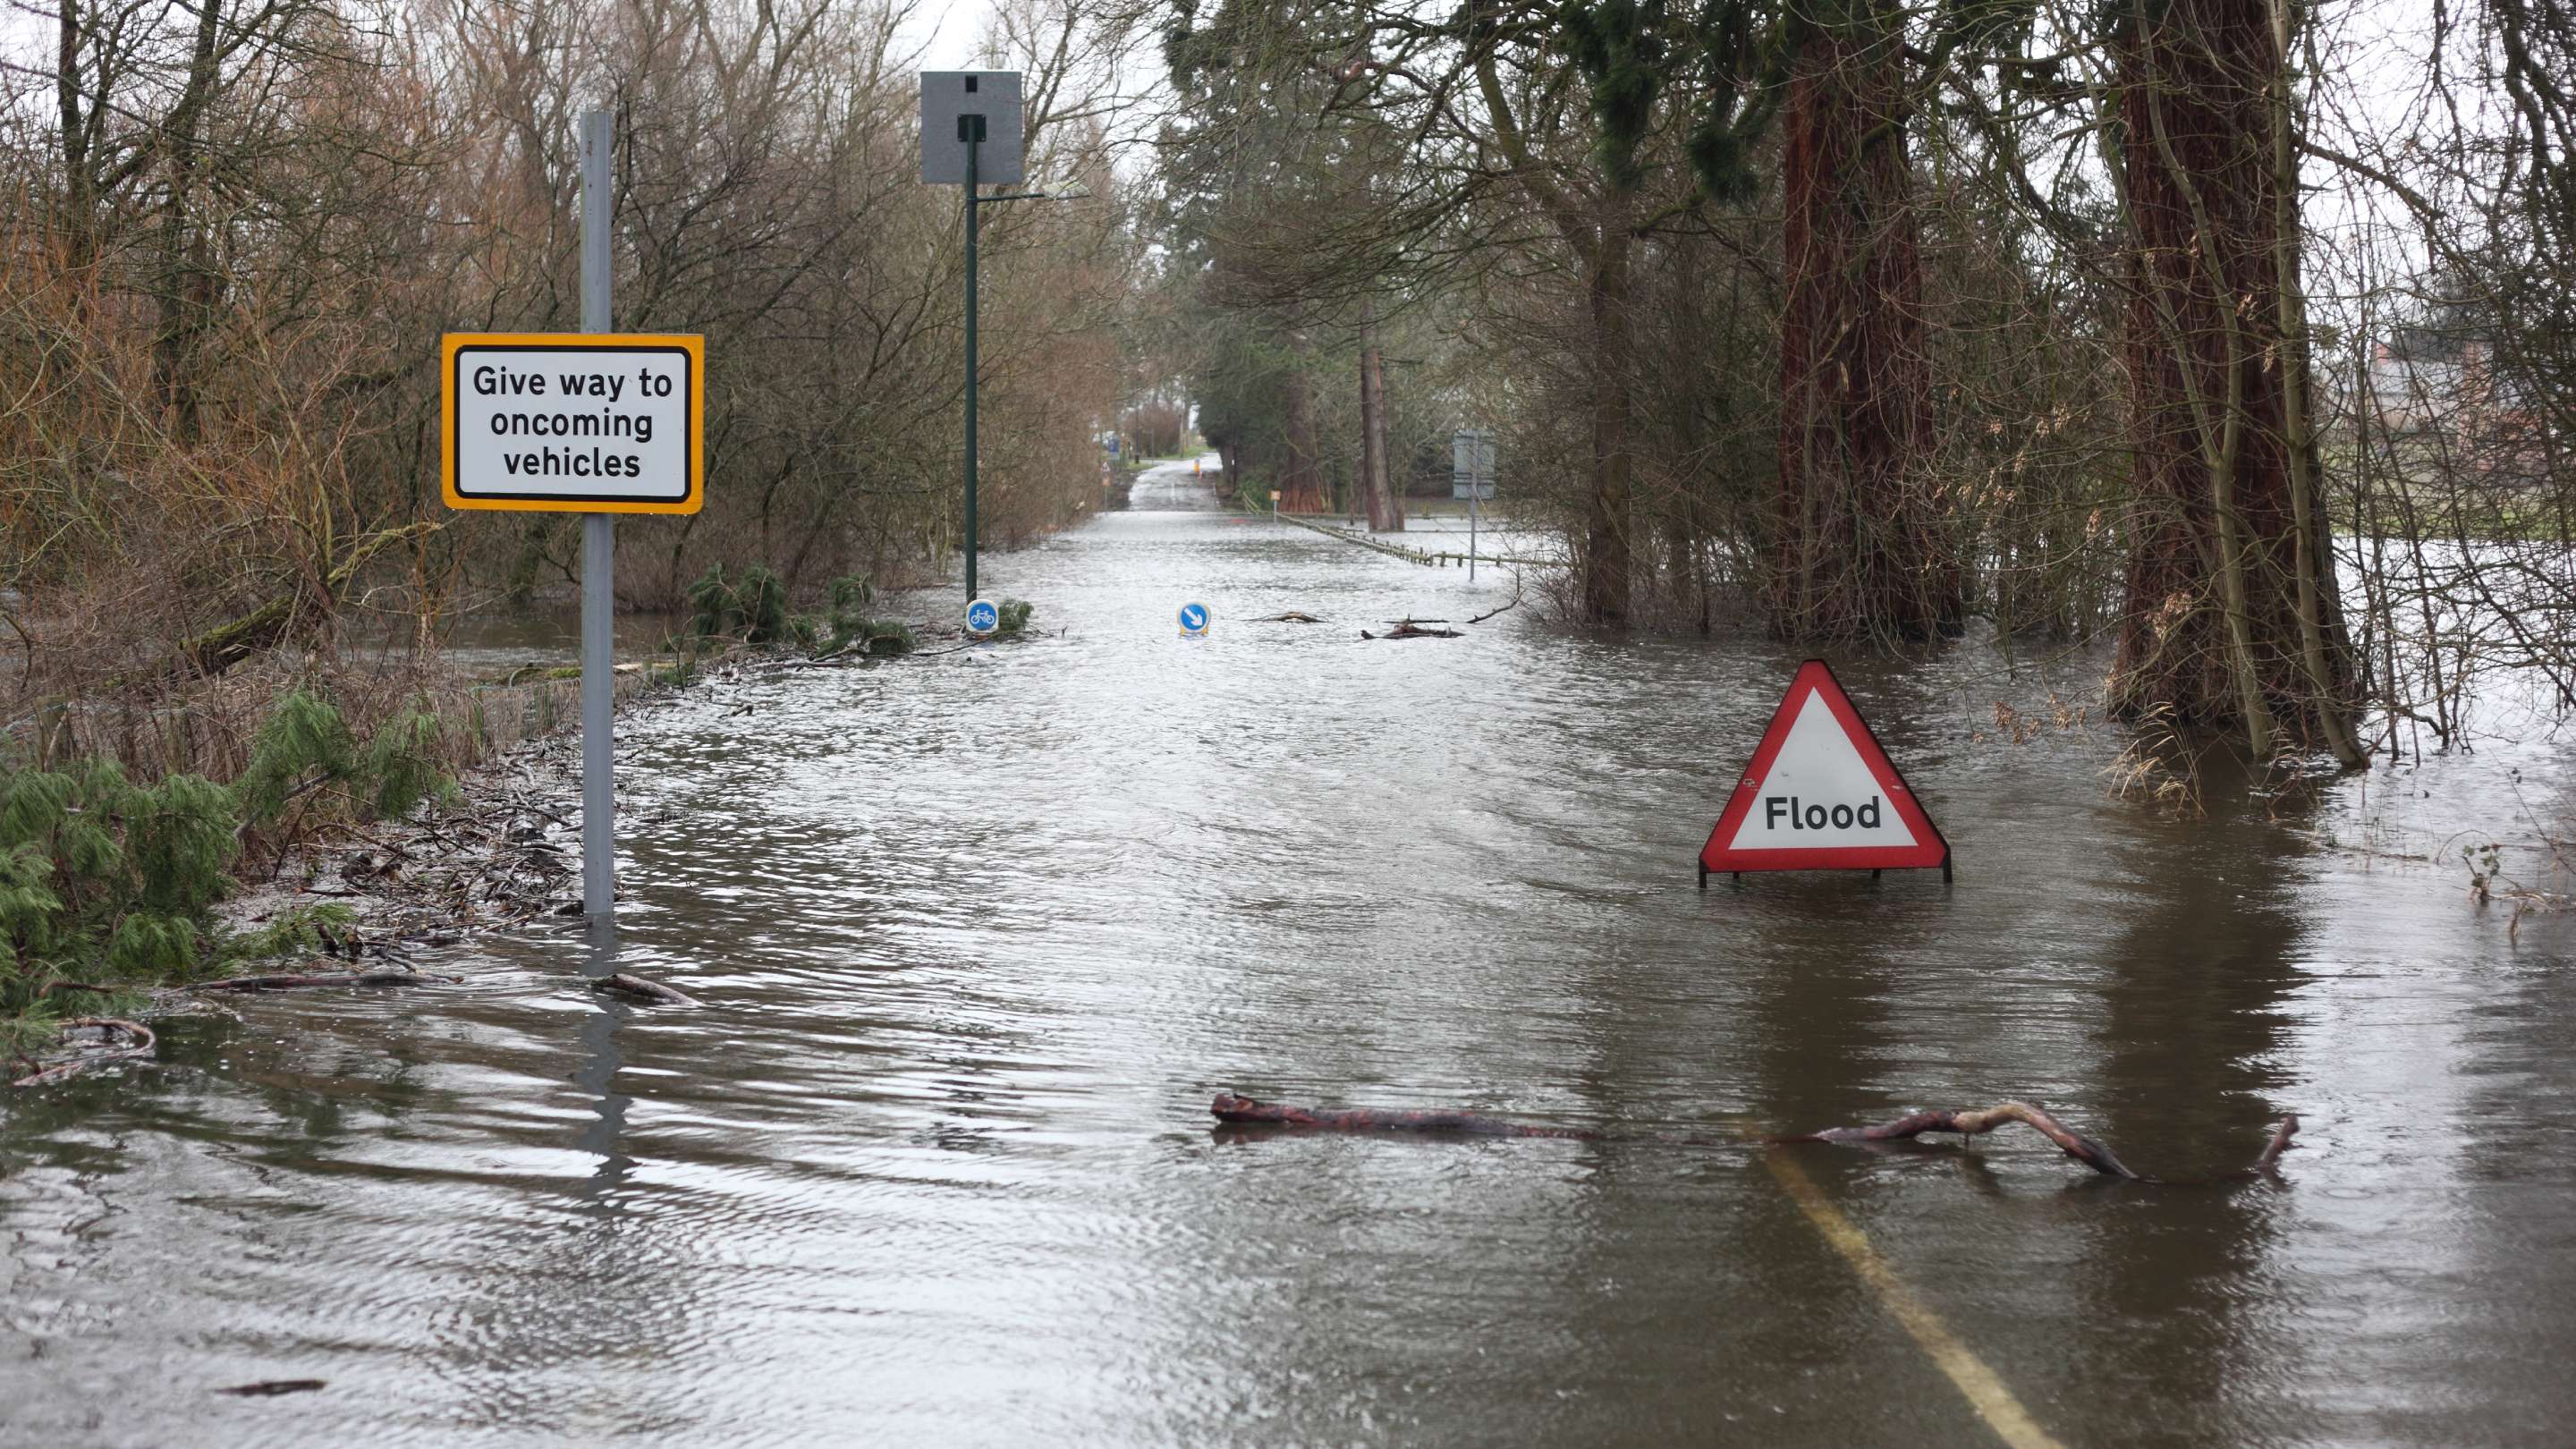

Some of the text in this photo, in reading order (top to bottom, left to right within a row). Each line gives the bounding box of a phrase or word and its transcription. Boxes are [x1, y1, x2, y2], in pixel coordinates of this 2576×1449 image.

[473, 366, 672, 402] Give way to
[491, 407, 652, 443] oncoming
[504, 446, 640, 477] vehicles
[1766, 796, 1881, 830] Flood
